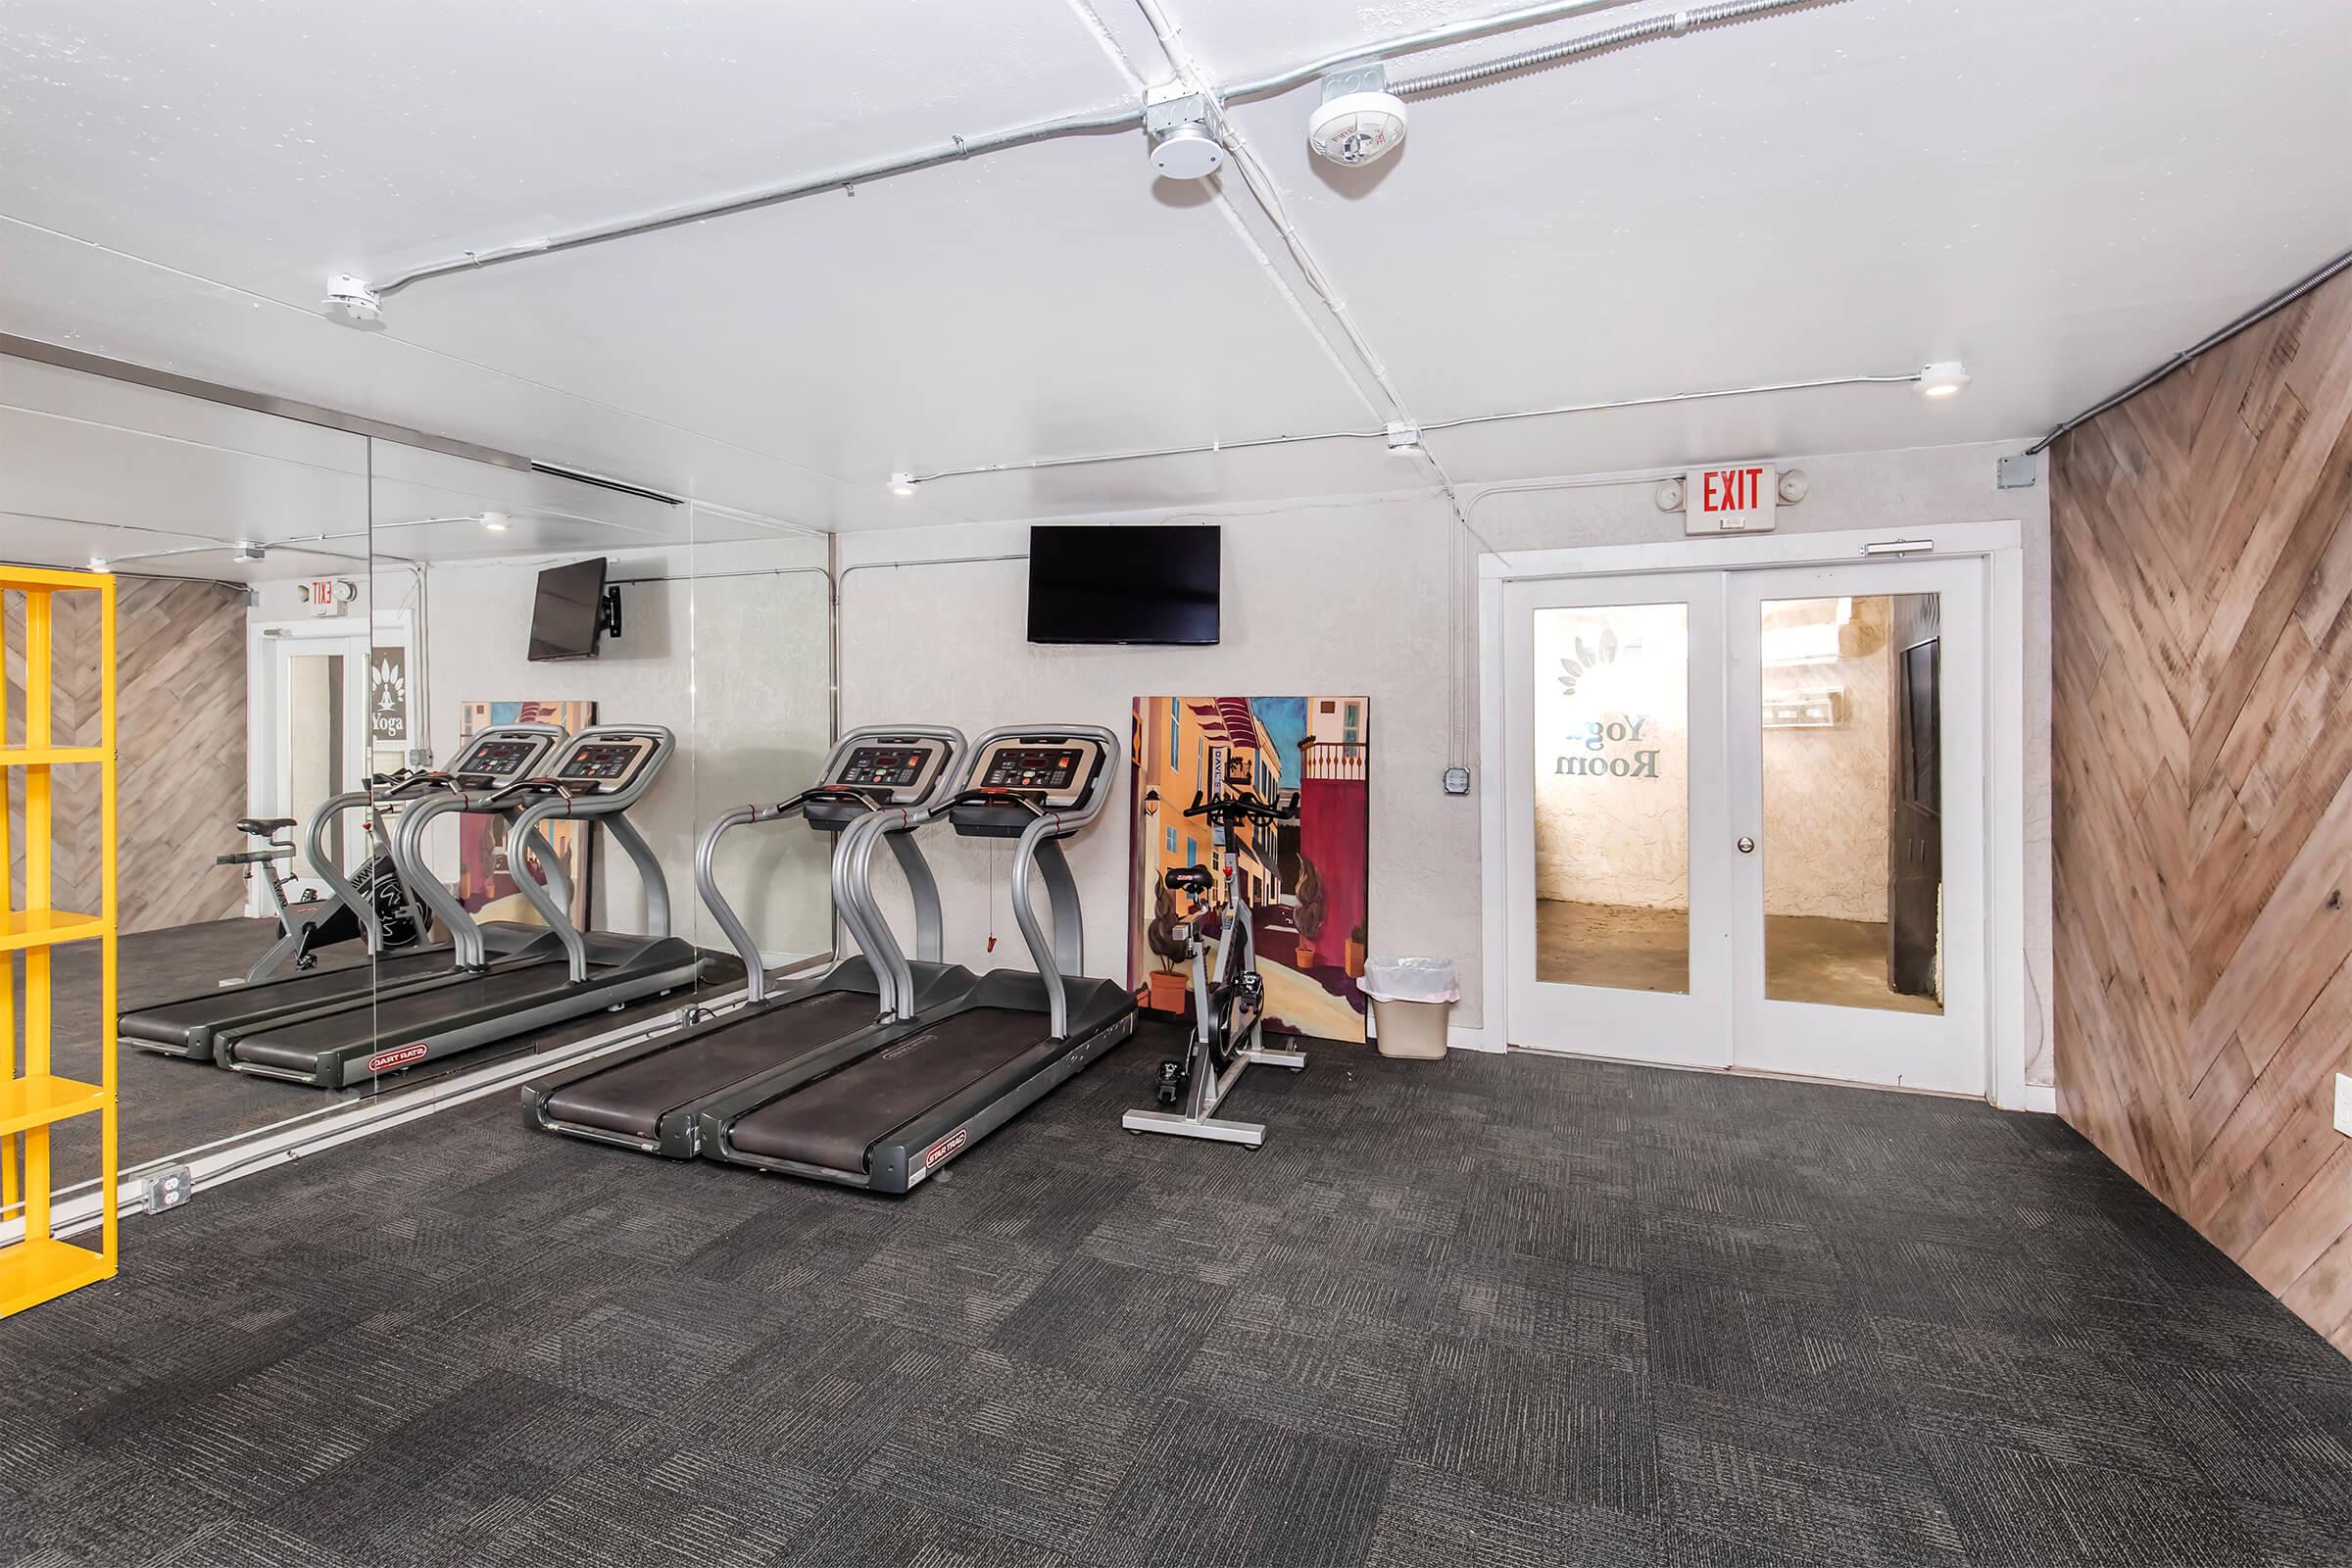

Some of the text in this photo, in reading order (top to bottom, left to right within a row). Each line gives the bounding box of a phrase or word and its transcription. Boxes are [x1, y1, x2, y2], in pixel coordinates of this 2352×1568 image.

[1332, 124, 1355, 142] FIRE
[1703, 467, 1763, 512] EXIT
[927, 1133, 964, 1163] STAR TRAC
